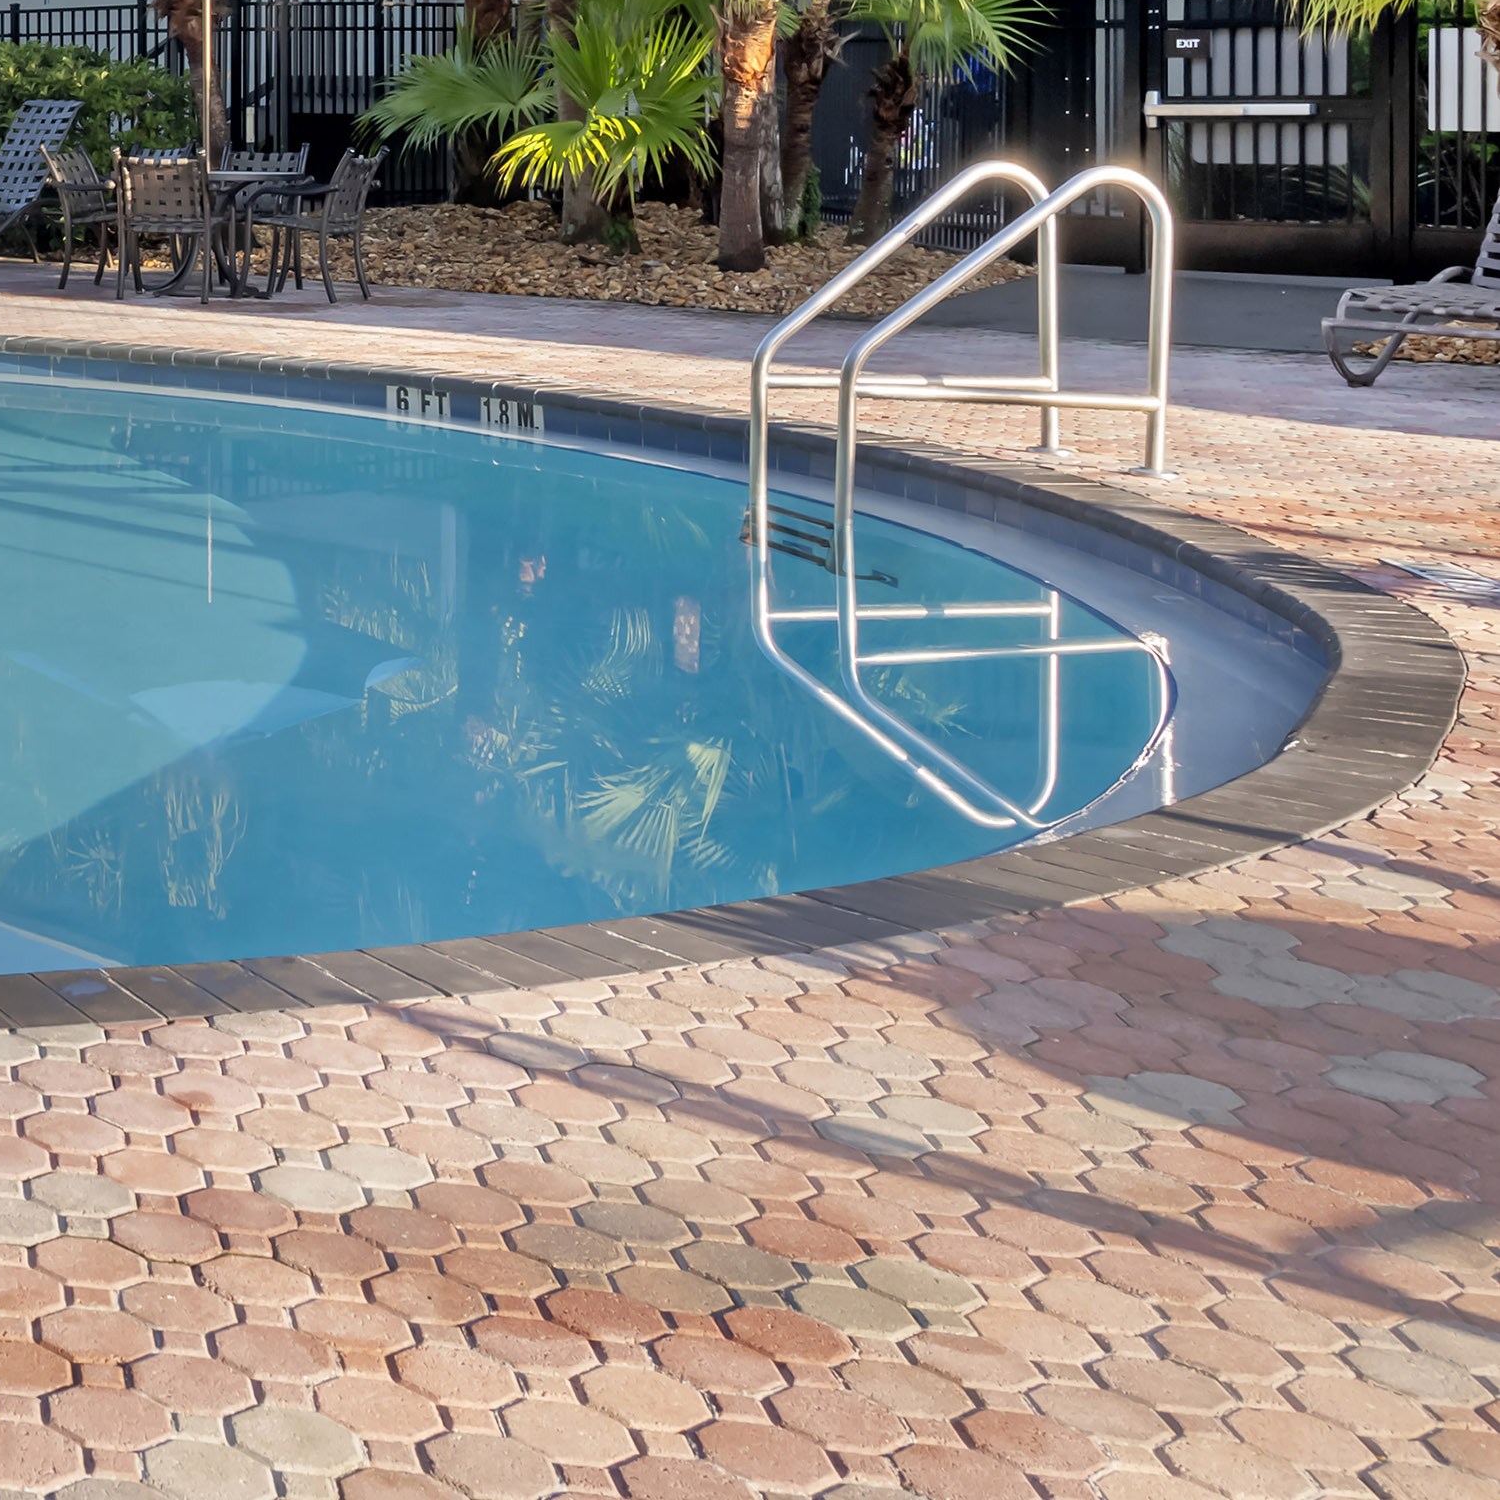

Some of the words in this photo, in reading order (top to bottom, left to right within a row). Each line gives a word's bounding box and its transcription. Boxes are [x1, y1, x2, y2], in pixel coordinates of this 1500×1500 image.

[1176, 38, 1200, 49] EXIT
[396, 386, 409, 411] 6
[483, 397, 510, 425] 1.8
